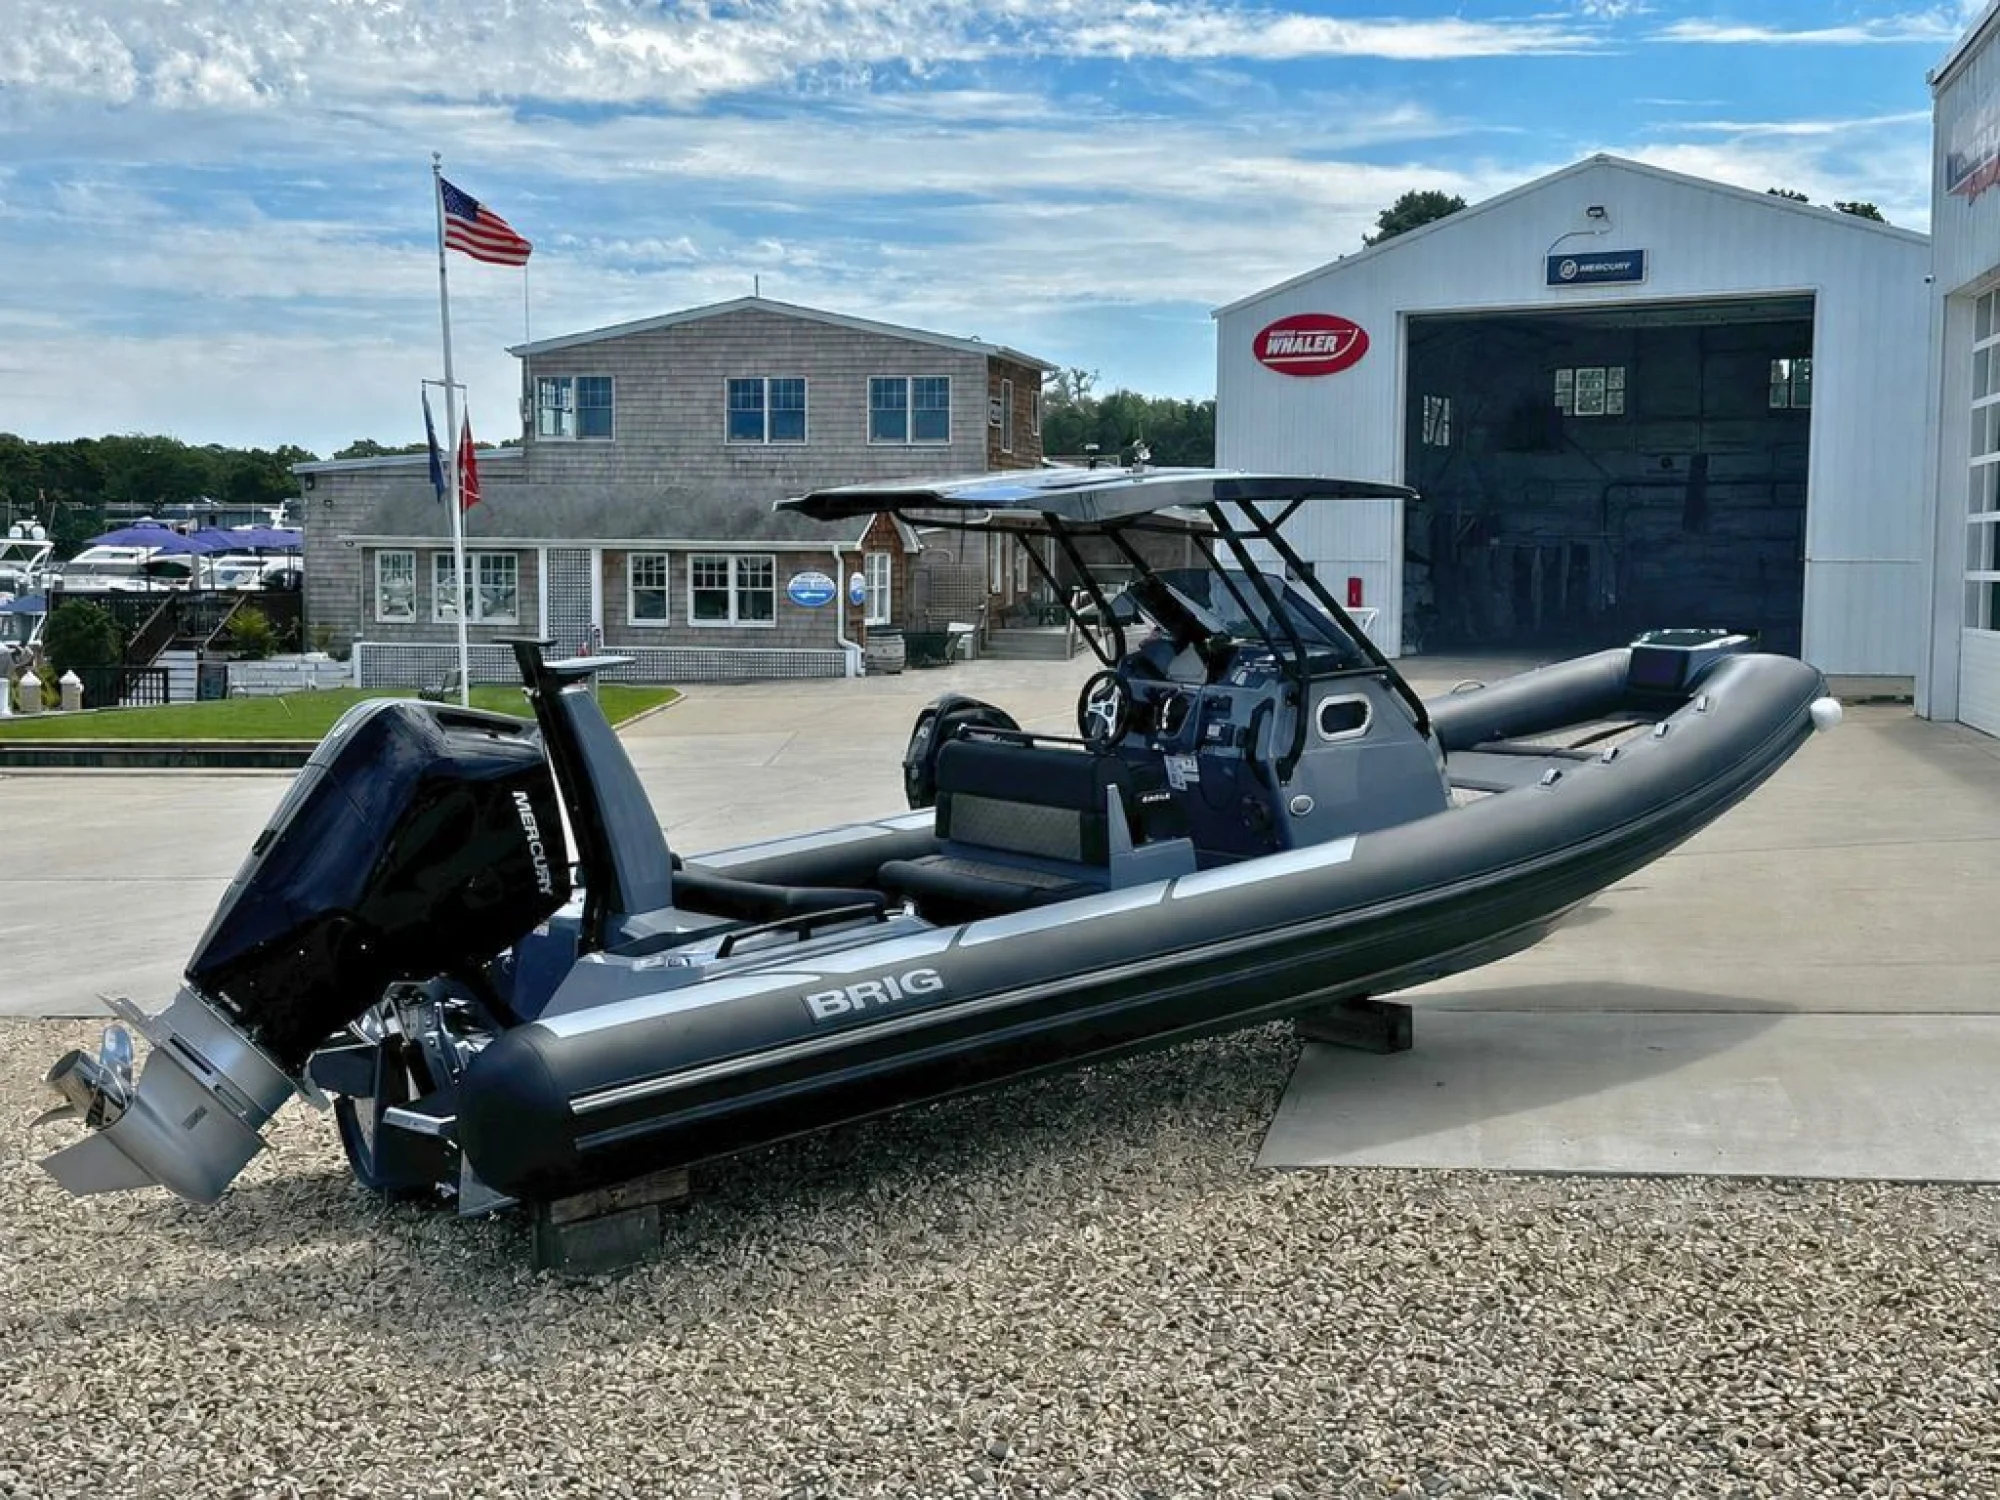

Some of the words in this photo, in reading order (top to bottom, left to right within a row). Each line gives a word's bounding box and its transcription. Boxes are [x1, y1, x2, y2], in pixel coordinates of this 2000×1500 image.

[1265, 335, 1339, 355] WHALER
[512, 791, 554, 895] MERCURY
[806, 968, 944, 1019] BRIG
